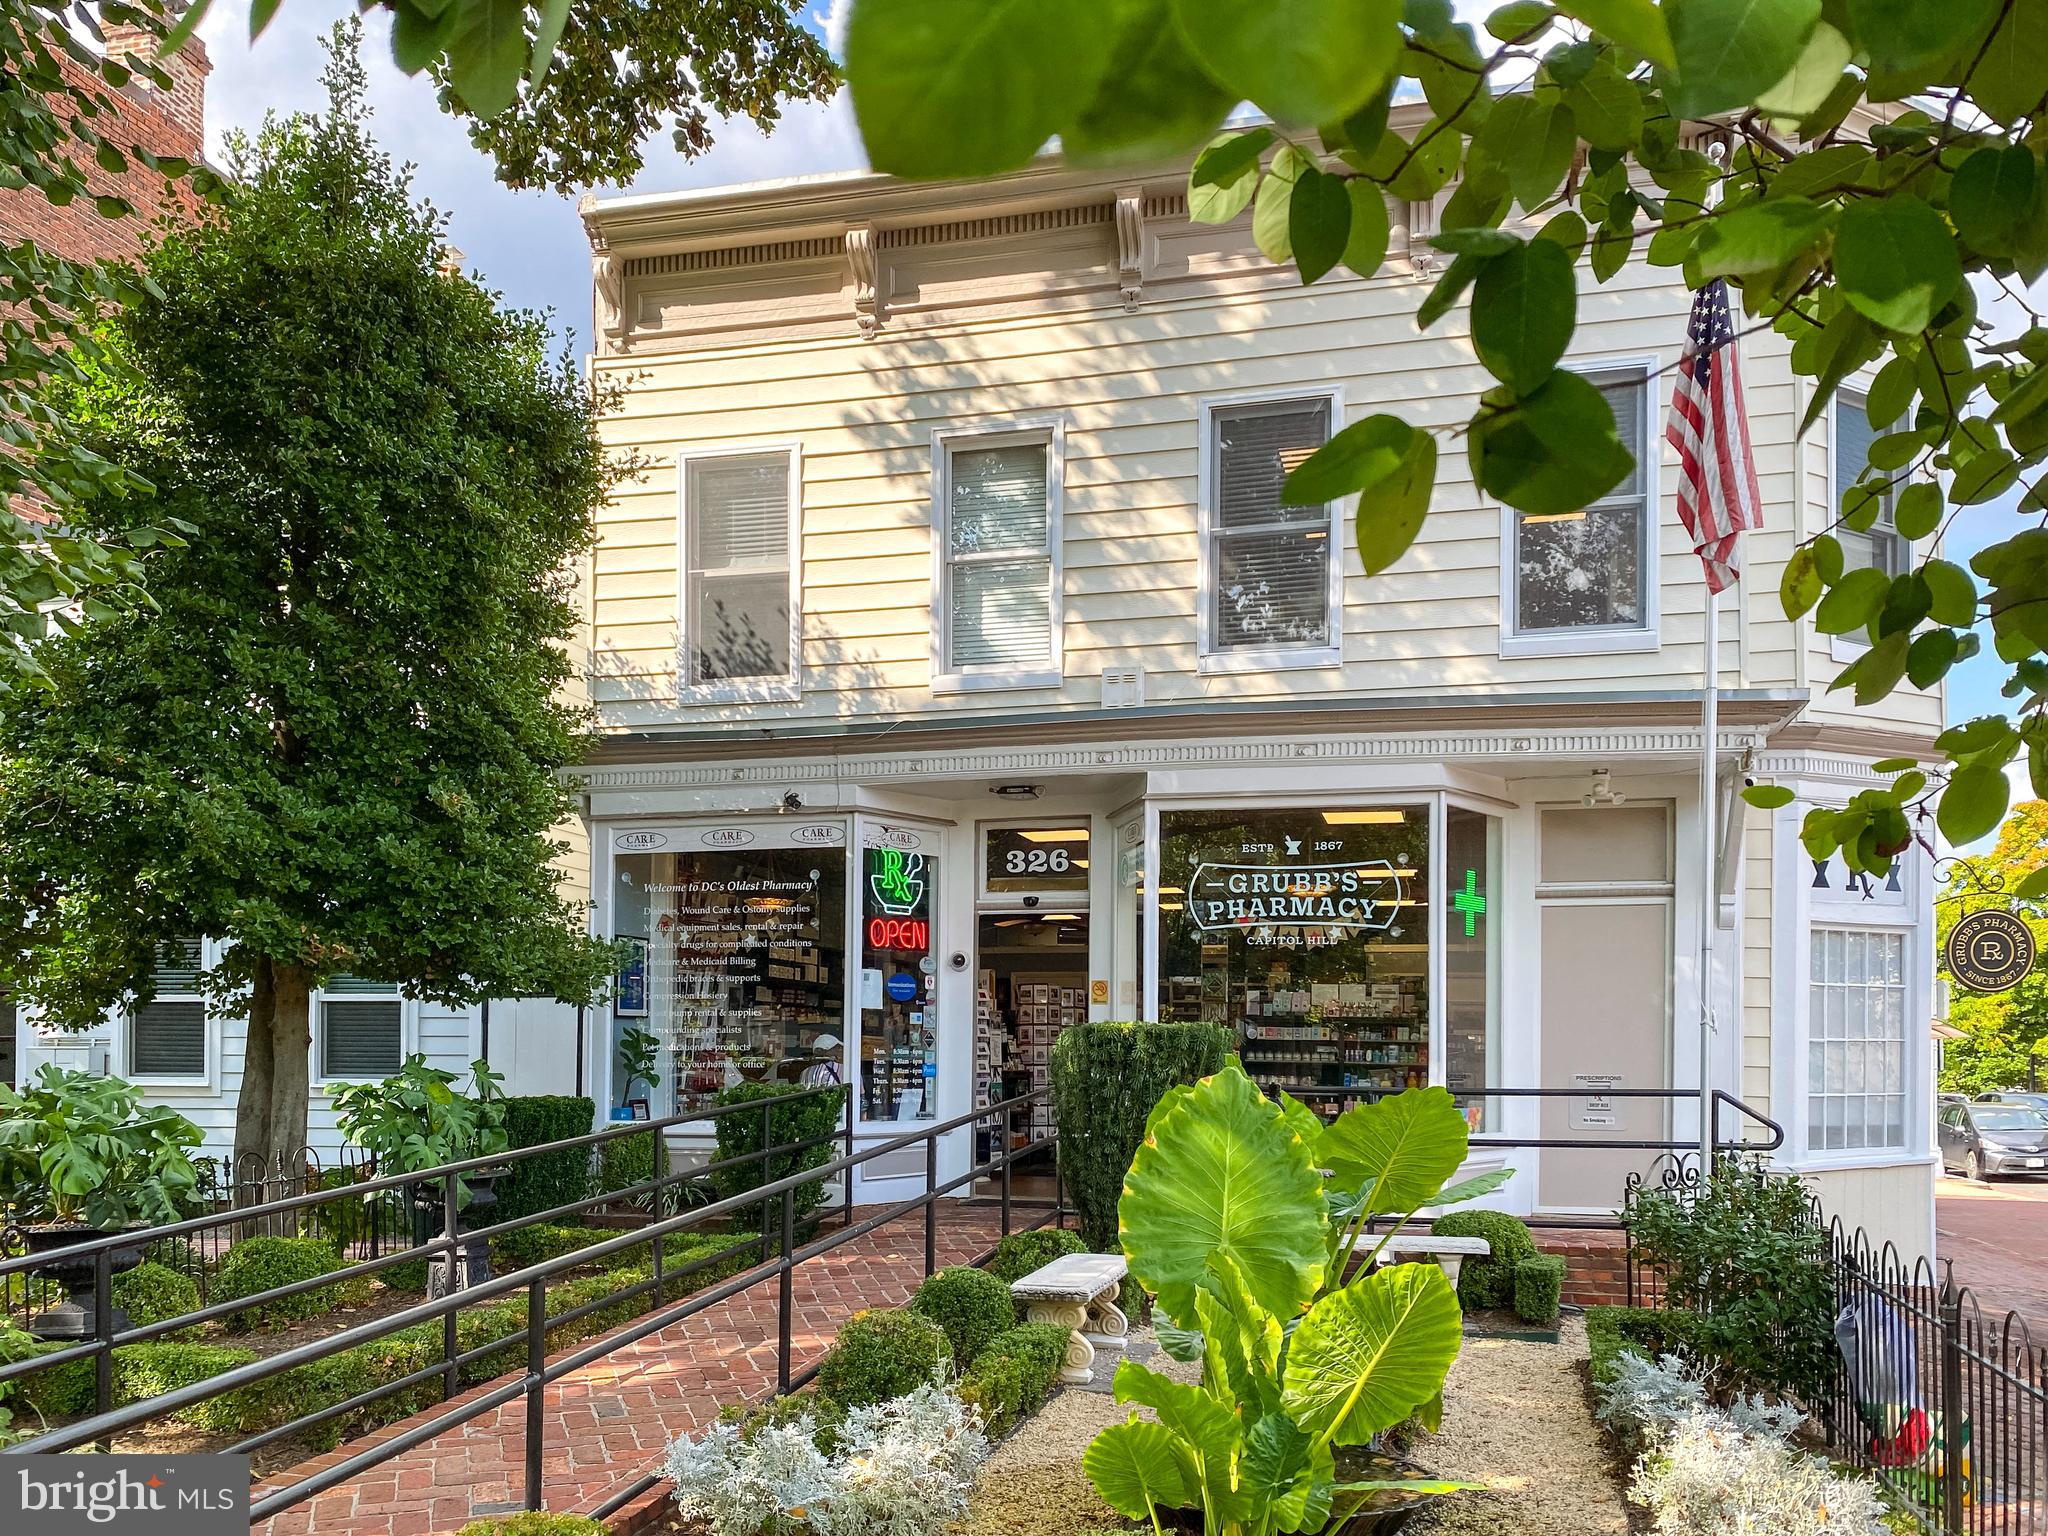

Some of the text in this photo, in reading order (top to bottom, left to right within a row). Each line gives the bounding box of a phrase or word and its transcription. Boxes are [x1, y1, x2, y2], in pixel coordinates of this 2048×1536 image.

[712, 831, 743, 841] CARE
[802, 828, 833, 837] CARE
[889, 832, 912, 844] CARE
[626, 834, 656, 844] CARE
[1314, 841, 1343, 851] 1867
[1006, 849, 1069, 873] 326
[644, 880, 813, 893] Welcome to DC's Oldest Pharmacy
[1228, 872, 1358, 894] GRUBB'S
[643, 904, 811, 916] Diabetes, Wound Care & Ostomy supplies
[1207, 896, 1379, 921] PHARMACY
[643, 924, 675, 933] Medical
[676, 923, 720, 934] equipment
[721, 922, 743, 932] sales,
[744, 922, 768, 931] rental
[779, 921, 804, 933] repair
[870, 918, 925, 949] OPEN
[645, 939, 812, 951] Specialty drugs for complicated conditions
[1246, 936, 1338, 945] CAPITOL HILL
[1956, 918, 2028, 966] GRUBB'S PHARMACY
[644, 956, 757, 967] Medicare & Medicaid Billing
[642, 974, 688, 985] Orthopedic
[689, 974, 715, 983] braces
[725, 974, 761, 985] supports
[1965, 970, 2017, 985] SINCE 1867
[642, 991, 728, 1002] Compression Hosiery
[669, 1009, 693, 1019] pump
[694, 1008, 718, 1017] rental
[719, 1009, 727, 1017] &
[728, 1008, 763, 1019] supplies
[642, 1025, 743, 1037] Compounding specialists
[715, 1042, 752, 1054] products
[677, 1060, 686, 1068] to
[687, 1060, 708, 1071] your
[709, 1059, 732, 1068] hom
[742, 1059, 766, 1068] office
